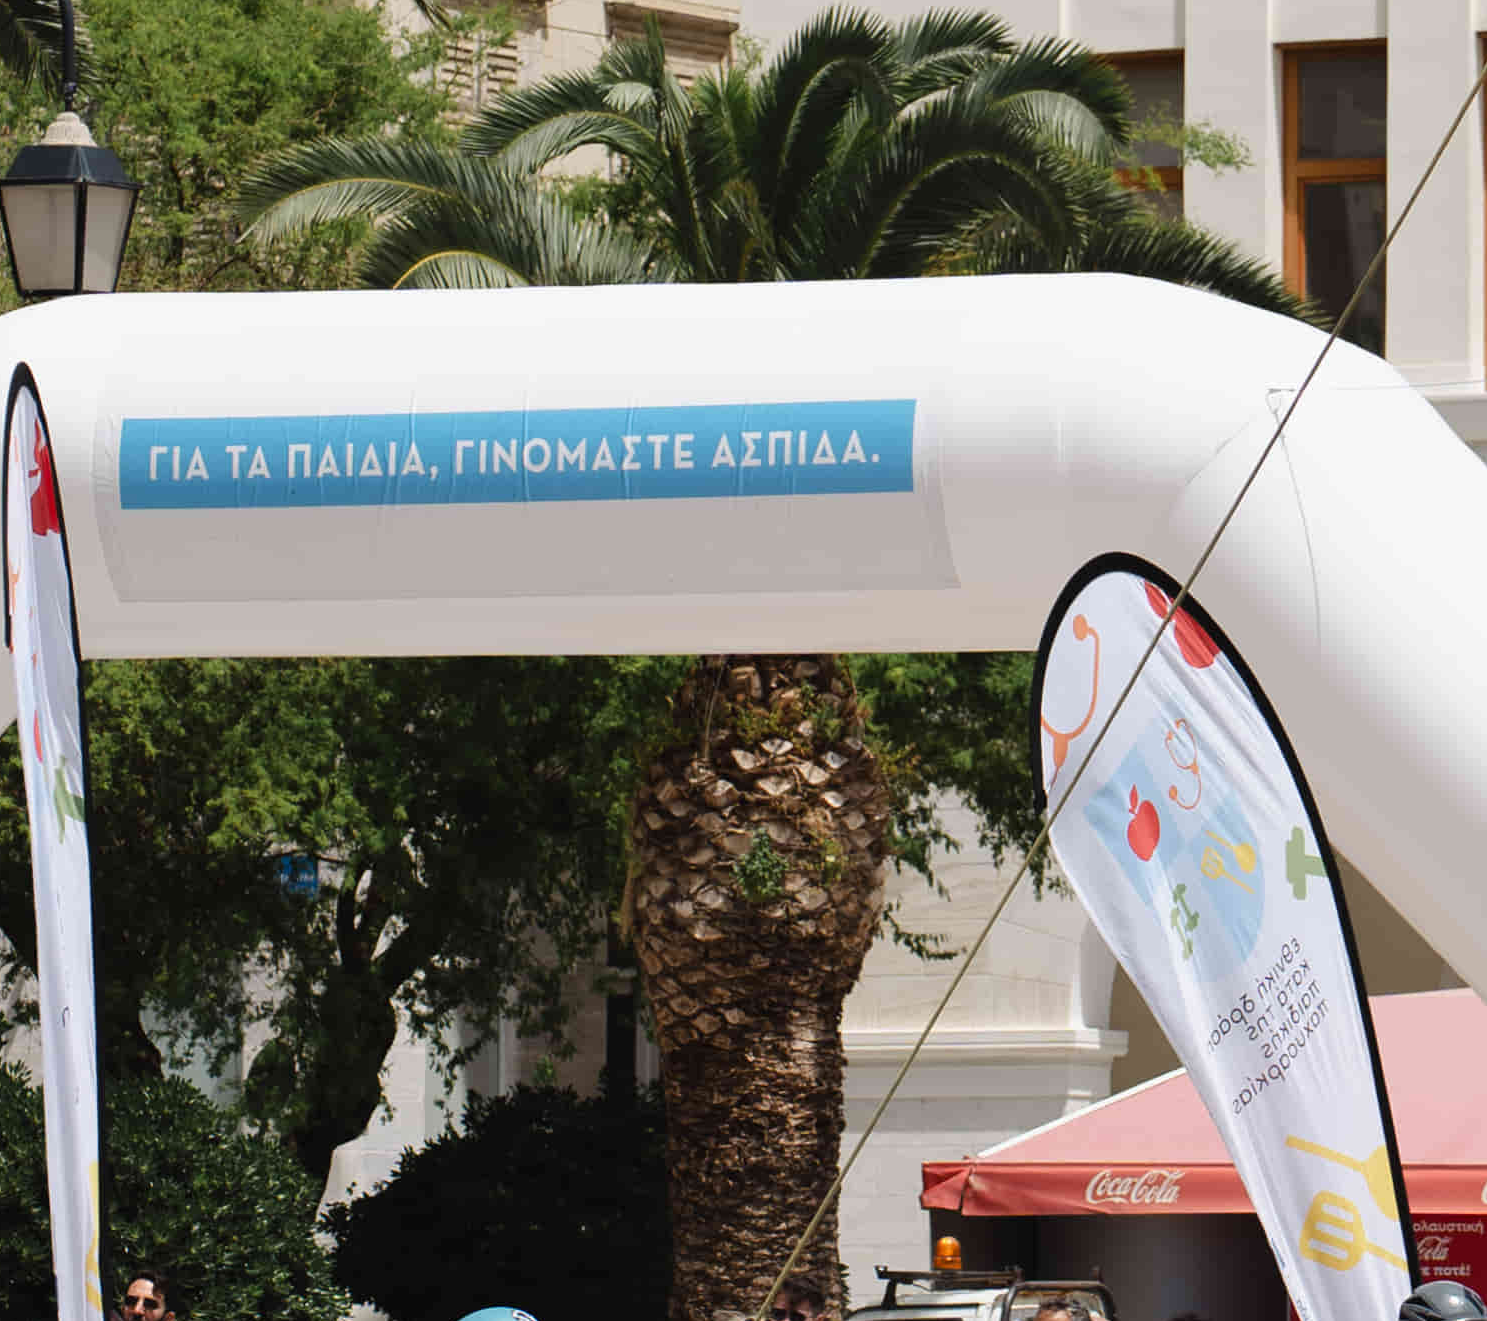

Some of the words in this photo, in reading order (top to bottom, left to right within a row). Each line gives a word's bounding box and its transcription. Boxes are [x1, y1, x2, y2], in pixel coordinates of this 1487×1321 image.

[149, 444, 209, 482] ΓΙΑ
[225, 443, 271, 481] ΤΑ
[288, 439, 440, 483] ΠΑΙΔΙΑ,
[454, 432, 695, 477] ΓΙΝΟΜΑΣΤΕ
[712, 427, 880, 468] ΑΣΠΙΔΑ.
[1086, 1169, 1185, 1205] Coca-Cola
[1413, 1219, 1484, 1235] ολαυστική
